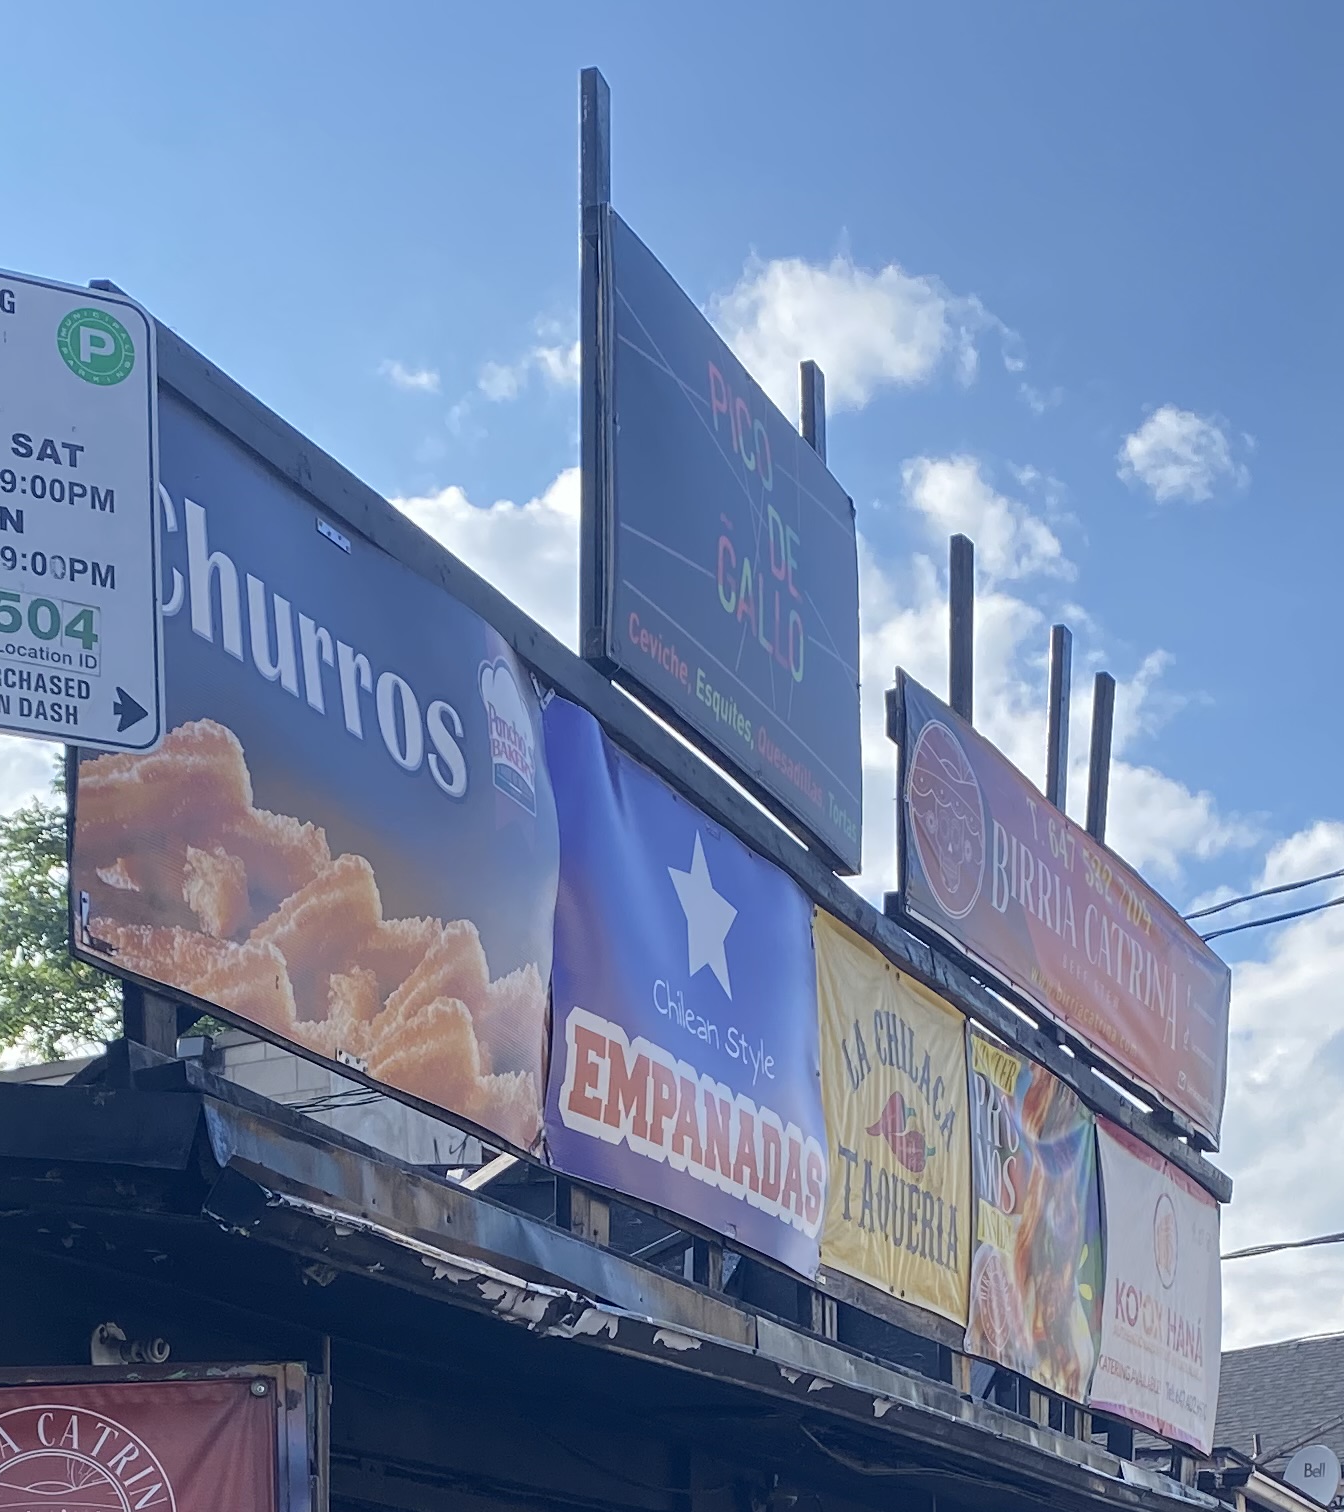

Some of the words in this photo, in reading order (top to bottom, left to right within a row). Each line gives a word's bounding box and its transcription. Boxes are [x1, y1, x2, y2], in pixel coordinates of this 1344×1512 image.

[79, 325, 116, 364] P
[10, 433, 85, 469] SAT
[708, 360, 773, 492] PICO
[0, 469, 116, 514] 9:00PM
[0, 545, 116, 591] 9:00PM
[767, 503, 803, 604] DE
[717, 534, 804, 683] GALLO
[19, 695, 79, 727] DASH
[78, 651, 98, 671] ID
[991, 817, 1077, 949] BIRRIA
[1083, 902, 1177, 1052] CATRINA
[652, 978, 721, 1051] Chilean
[724, 1027, 776, 1086] Style
[841, 1018, 872, 1093] LA
[873, 1009, 956, 1153] CHILACA
[564, 1016, 826, 1231] EMPANADAS
[837, 1139, 959, 1273] TAQUERIA
[1304, 1461, 1326, 1479] Bell
